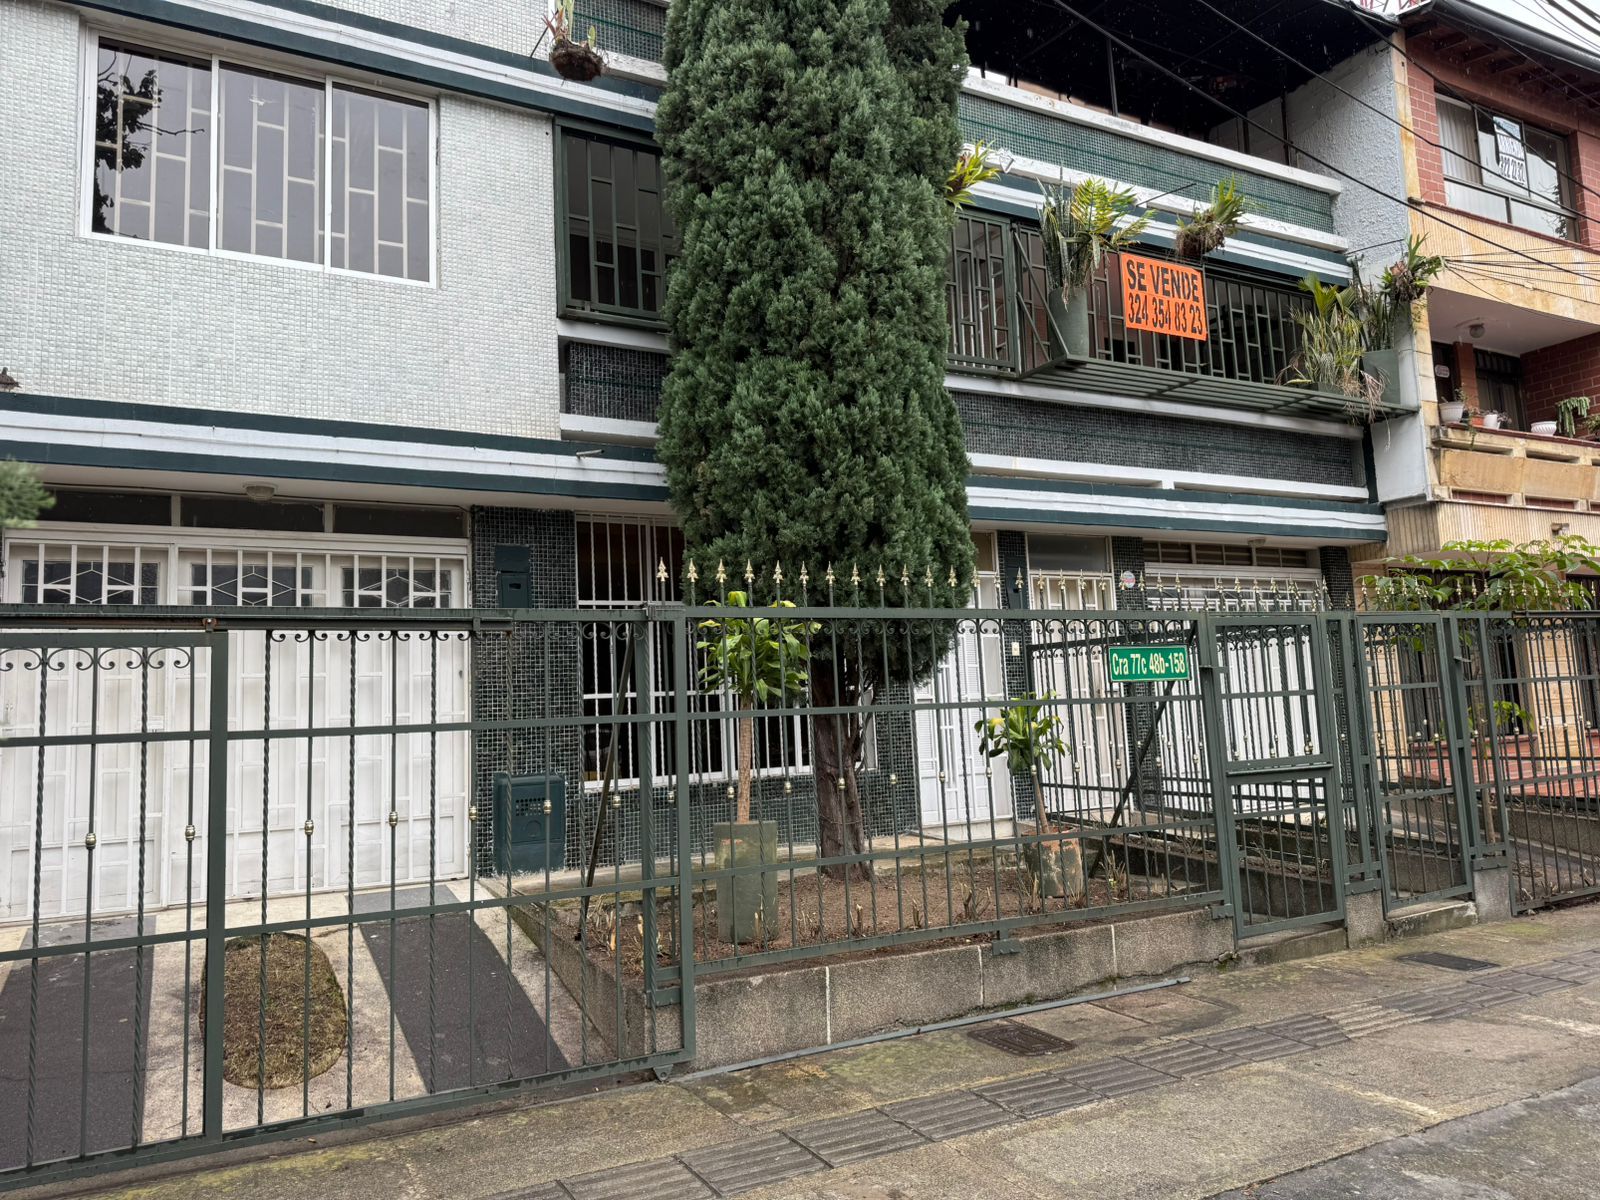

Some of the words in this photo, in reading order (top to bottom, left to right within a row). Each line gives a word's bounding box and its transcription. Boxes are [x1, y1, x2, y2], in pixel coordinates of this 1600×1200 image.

[1126, 259, 1147, 292] SE
[1150, 264, 1200, 302] VENDE
[1128, 292, 1148, 325] 324
[1152, 297, 1171, 330] 354
[1174, 302, 1188, 333] 83
[1189, 304, 1203, 335] 23
[1112, 653, 1129, 675] Cra
[1130, 653, 1147, 675] 77c
[1149, 652, 1186, 675] 48b-158
